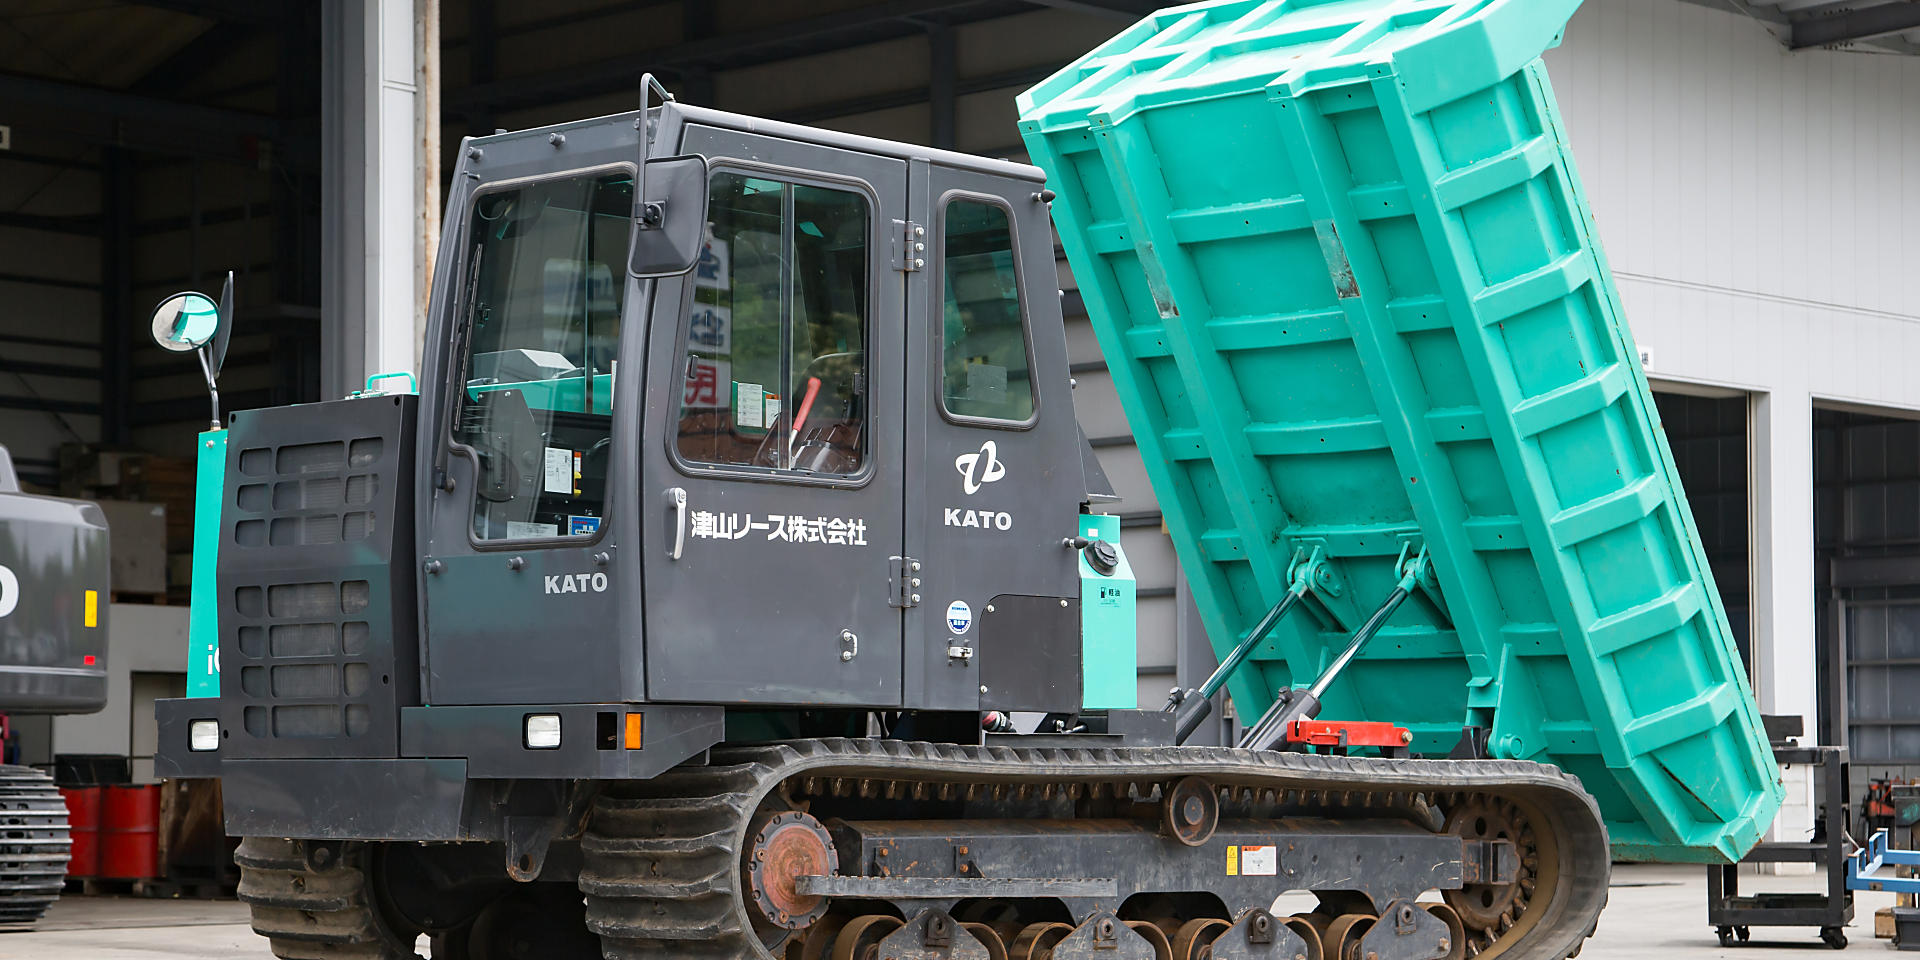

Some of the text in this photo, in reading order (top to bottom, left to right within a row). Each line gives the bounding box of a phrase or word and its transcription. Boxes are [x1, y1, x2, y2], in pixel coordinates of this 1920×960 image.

[691, 510, 868, 546] 津山リース株式会社
[944, 508, 1012, 531] KATO
[544, 573, 608, 594] KATO
